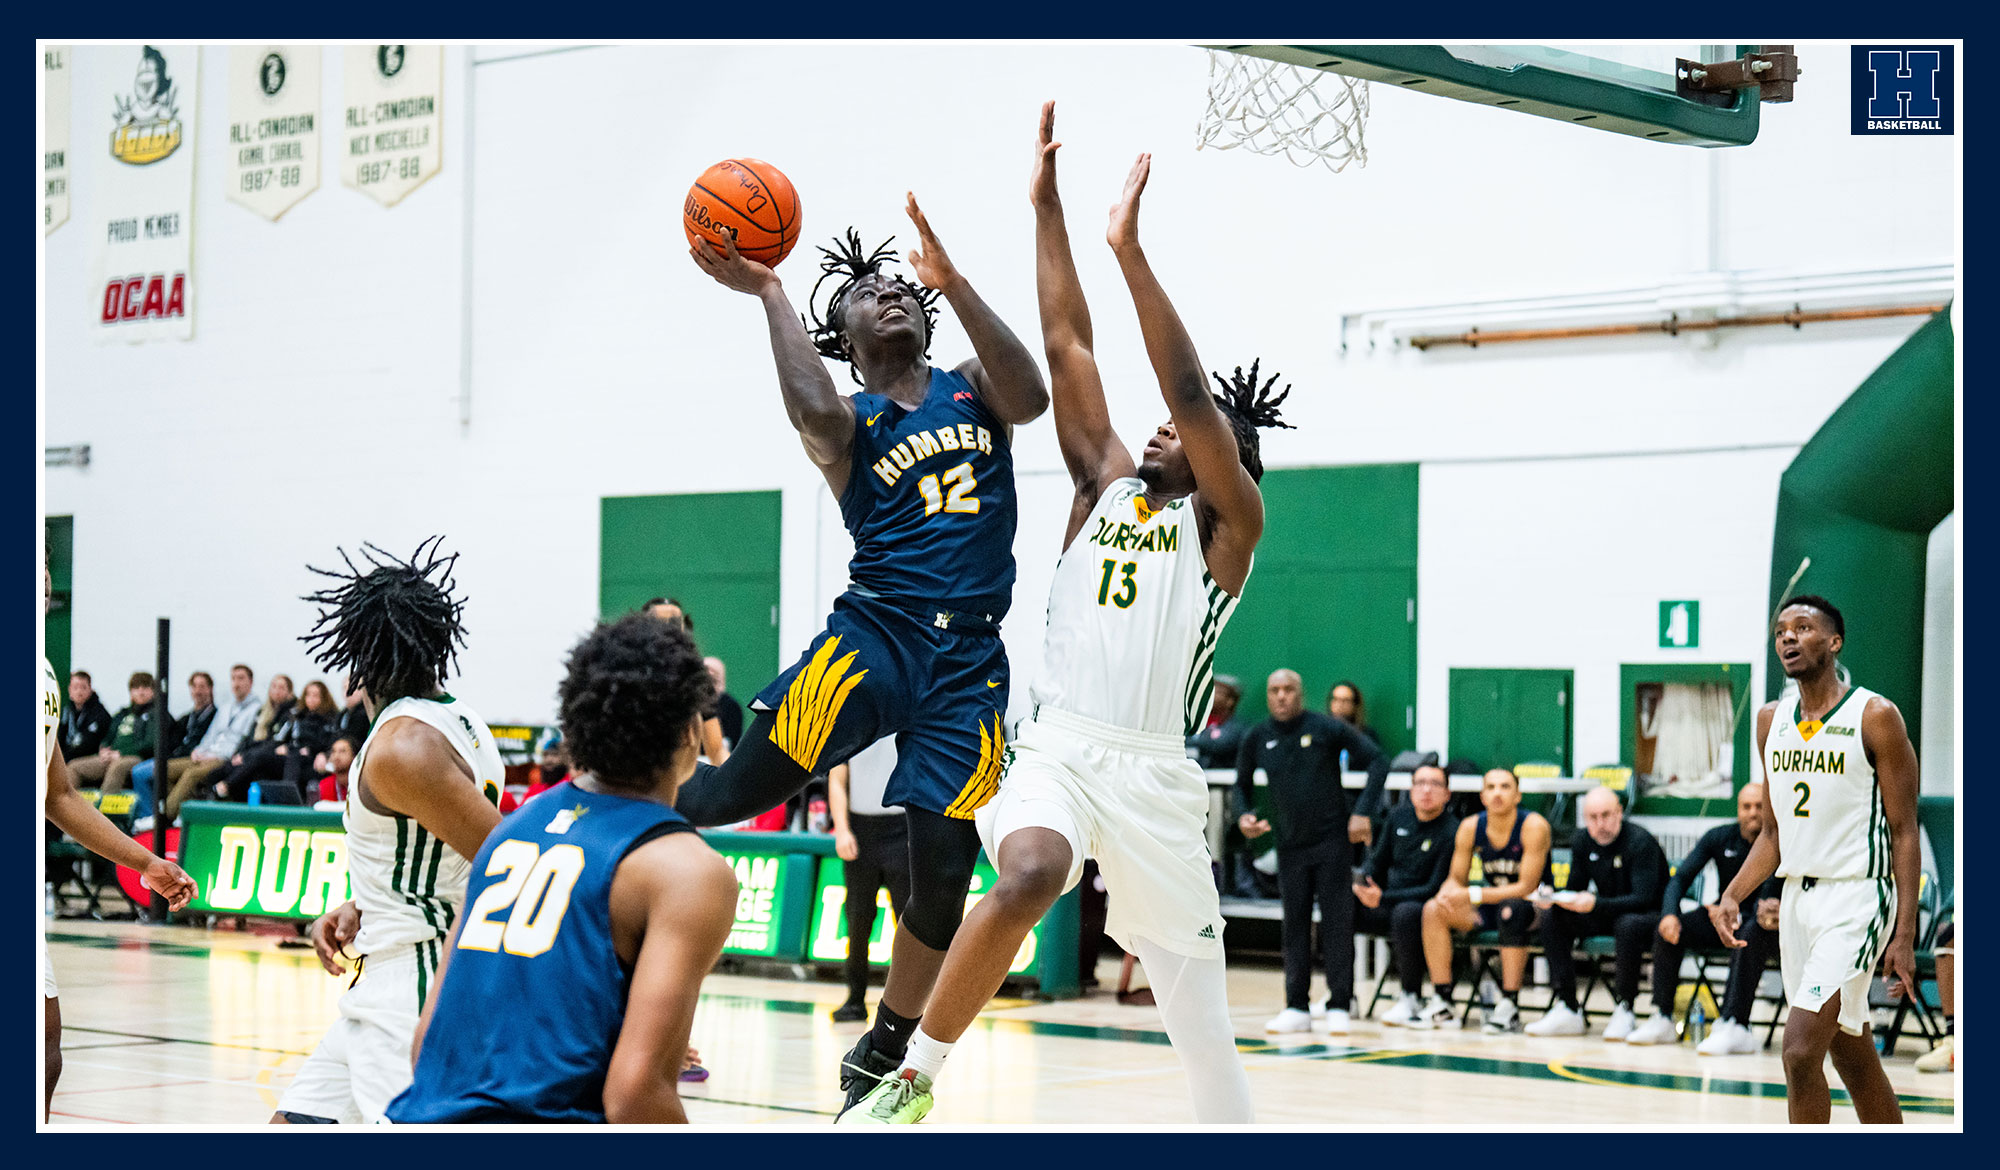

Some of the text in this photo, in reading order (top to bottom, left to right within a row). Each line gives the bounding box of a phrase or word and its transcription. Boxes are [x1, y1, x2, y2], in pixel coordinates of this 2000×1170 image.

[229, 114, 314, 144] ALL-CANADIAN
[345, 96, 434, 128] ALL-CANADIAN
[240, 165, 301, 193] 1987-88
[356, 156, 420, 186] 1987-88
[107, 213, 180, 244] PROUD MEMBER
[684, 192, 739, 242] Wilson
[101, 272, 186, 324] OCAA
[872, 423, 993, 487] HUMBER
[917, 461, 981, 517] 12
[1098, 558, 1138, 609] 13
[1825, 725, 1856, 737] OCAA
[1772, 750, 1845, 775] DURHAM
[1793, 781, 1811, 818] 2
[210, 826, 356, 916] DUR
[725, 855, 779, 890] AM
[457, 838, 586, 959] 20
